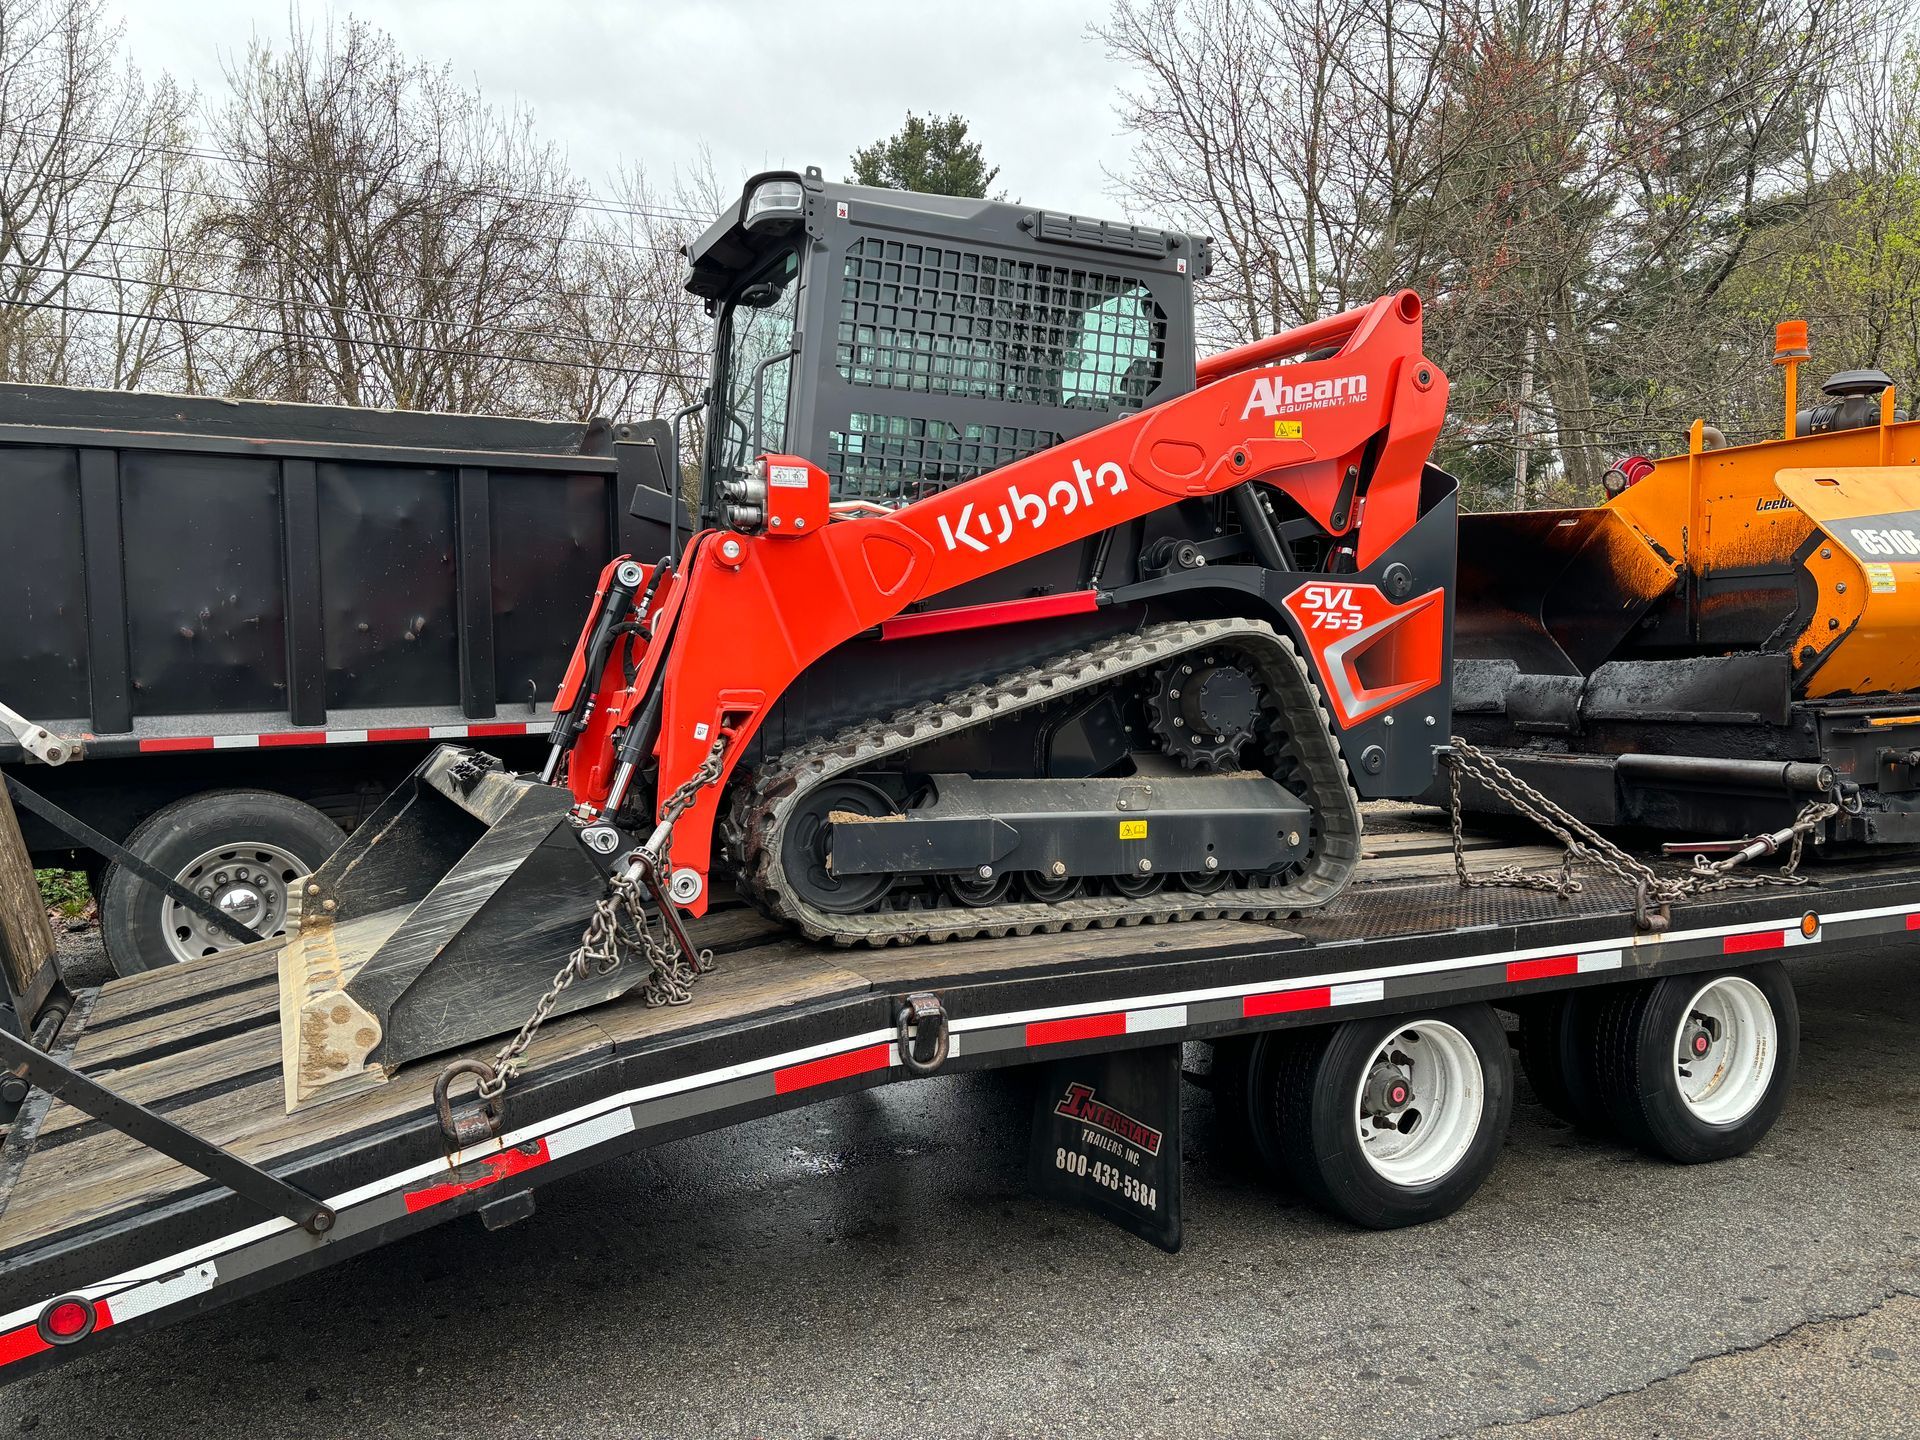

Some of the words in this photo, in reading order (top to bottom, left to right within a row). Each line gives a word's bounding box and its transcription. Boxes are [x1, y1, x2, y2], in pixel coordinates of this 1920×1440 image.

[1239, 374, 1367, 420] Ahearn
[1279, 397, 1345, 414] EQUIPMENT,
[1349, 393, 1368, 404] INC
[936, 458, 1129, 552] Kubota
[1300, 587, 1362, 611] SVL
[1311, 611, 1364, 631] 75-3
[1056, 1084, 1161, 1152] INTERSTATE
[1125, 1148, 1140, 1167] INC.
[1055, 1147, 1157, 1211] 800-433-5384
